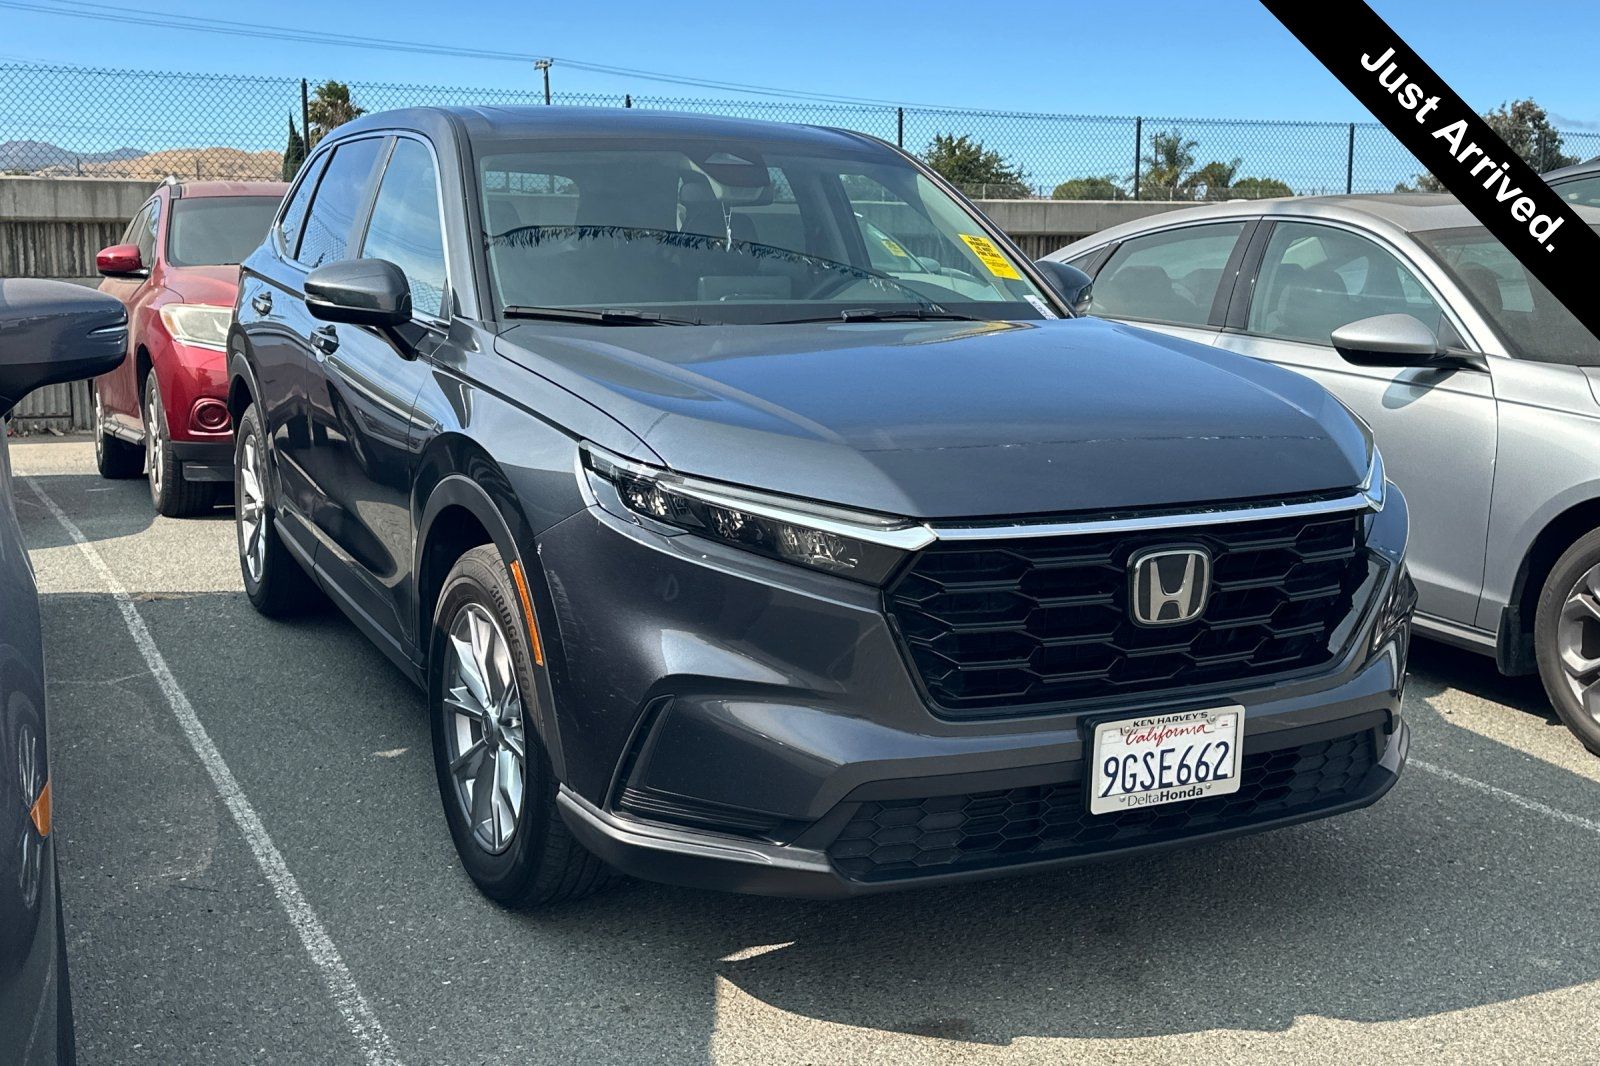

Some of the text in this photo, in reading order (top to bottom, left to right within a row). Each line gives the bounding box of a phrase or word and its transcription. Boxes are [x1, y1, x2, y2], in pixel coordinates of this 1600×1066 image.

[1133, 718, 1155, 728] KEN
[1157, 711, 1208, 725] HARVEY'S
[1125, 722, 1214, 747] California
[1101, 741, 1230, 798] 9GSE662
